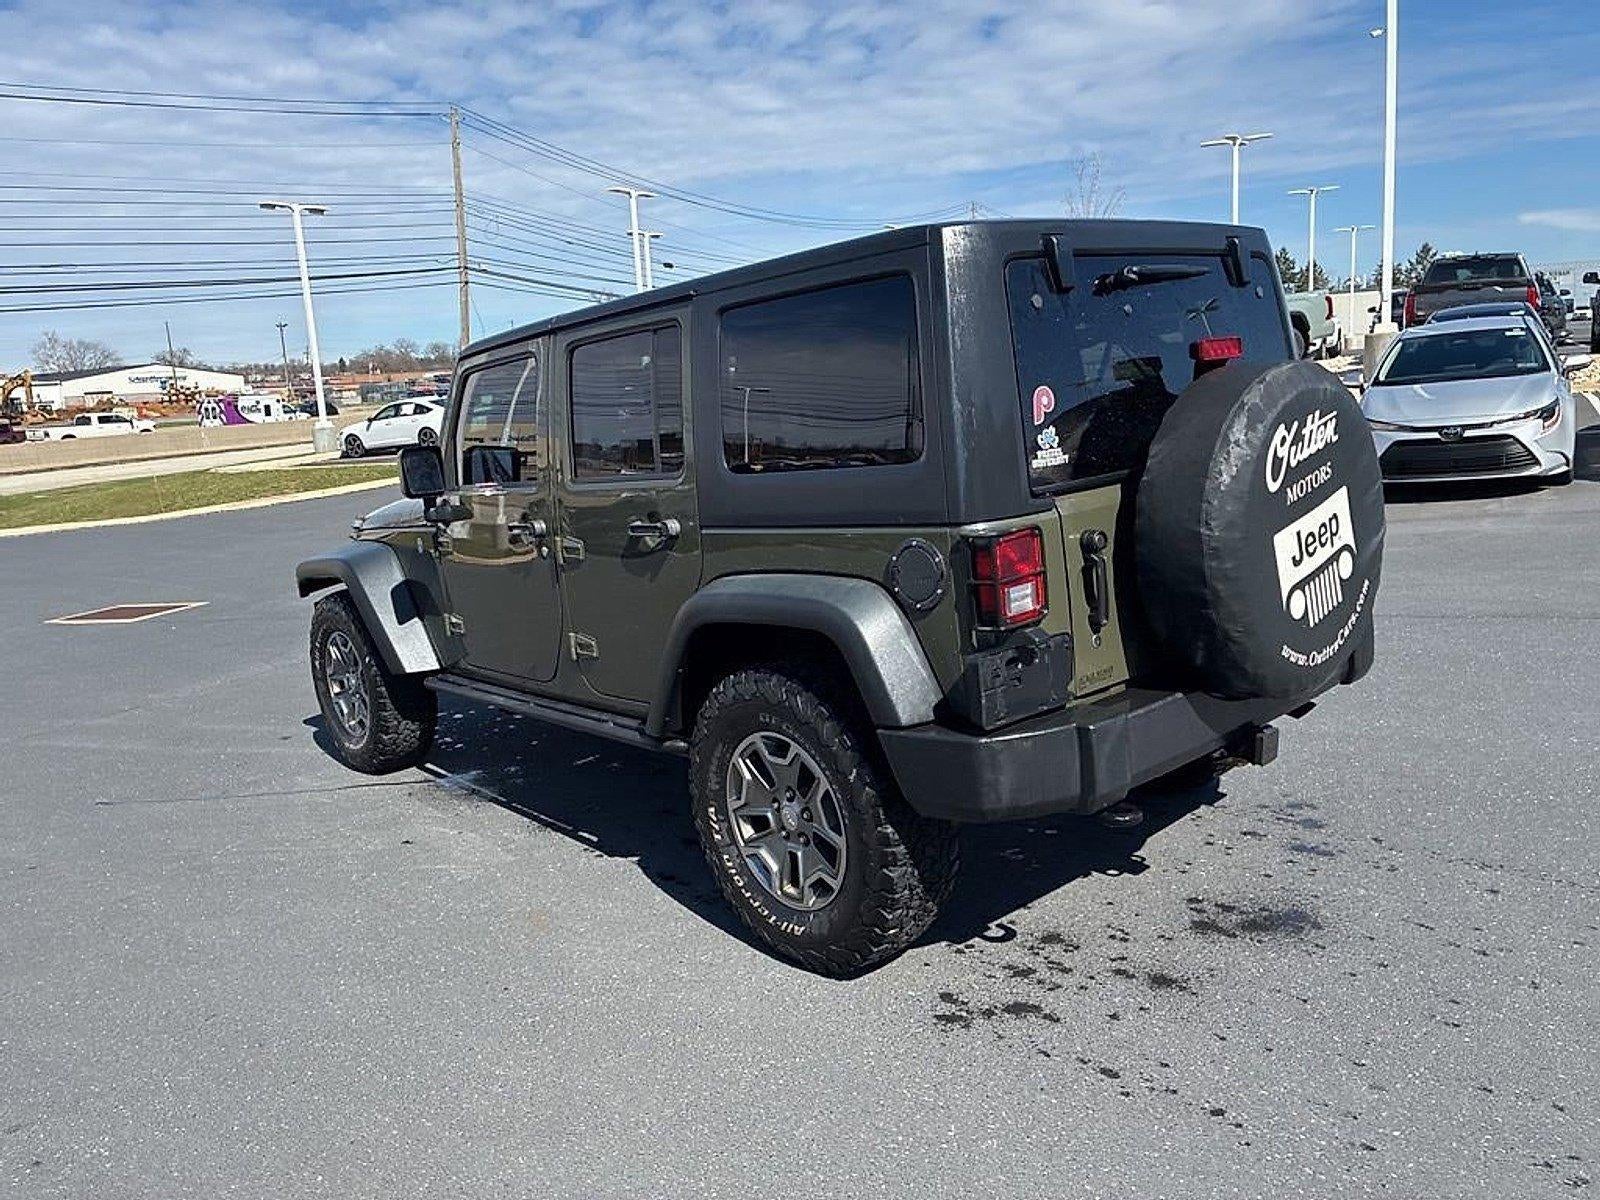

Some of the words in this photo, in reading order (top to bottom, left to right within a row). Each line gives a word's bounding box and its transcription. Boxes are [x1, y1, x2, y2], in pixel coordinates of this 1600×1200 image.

[1265, 409, 1339, 493] Outten
[1286, 461, 1333, 506] MOTORS
[1291, 512, 1340, 567] Jeep
